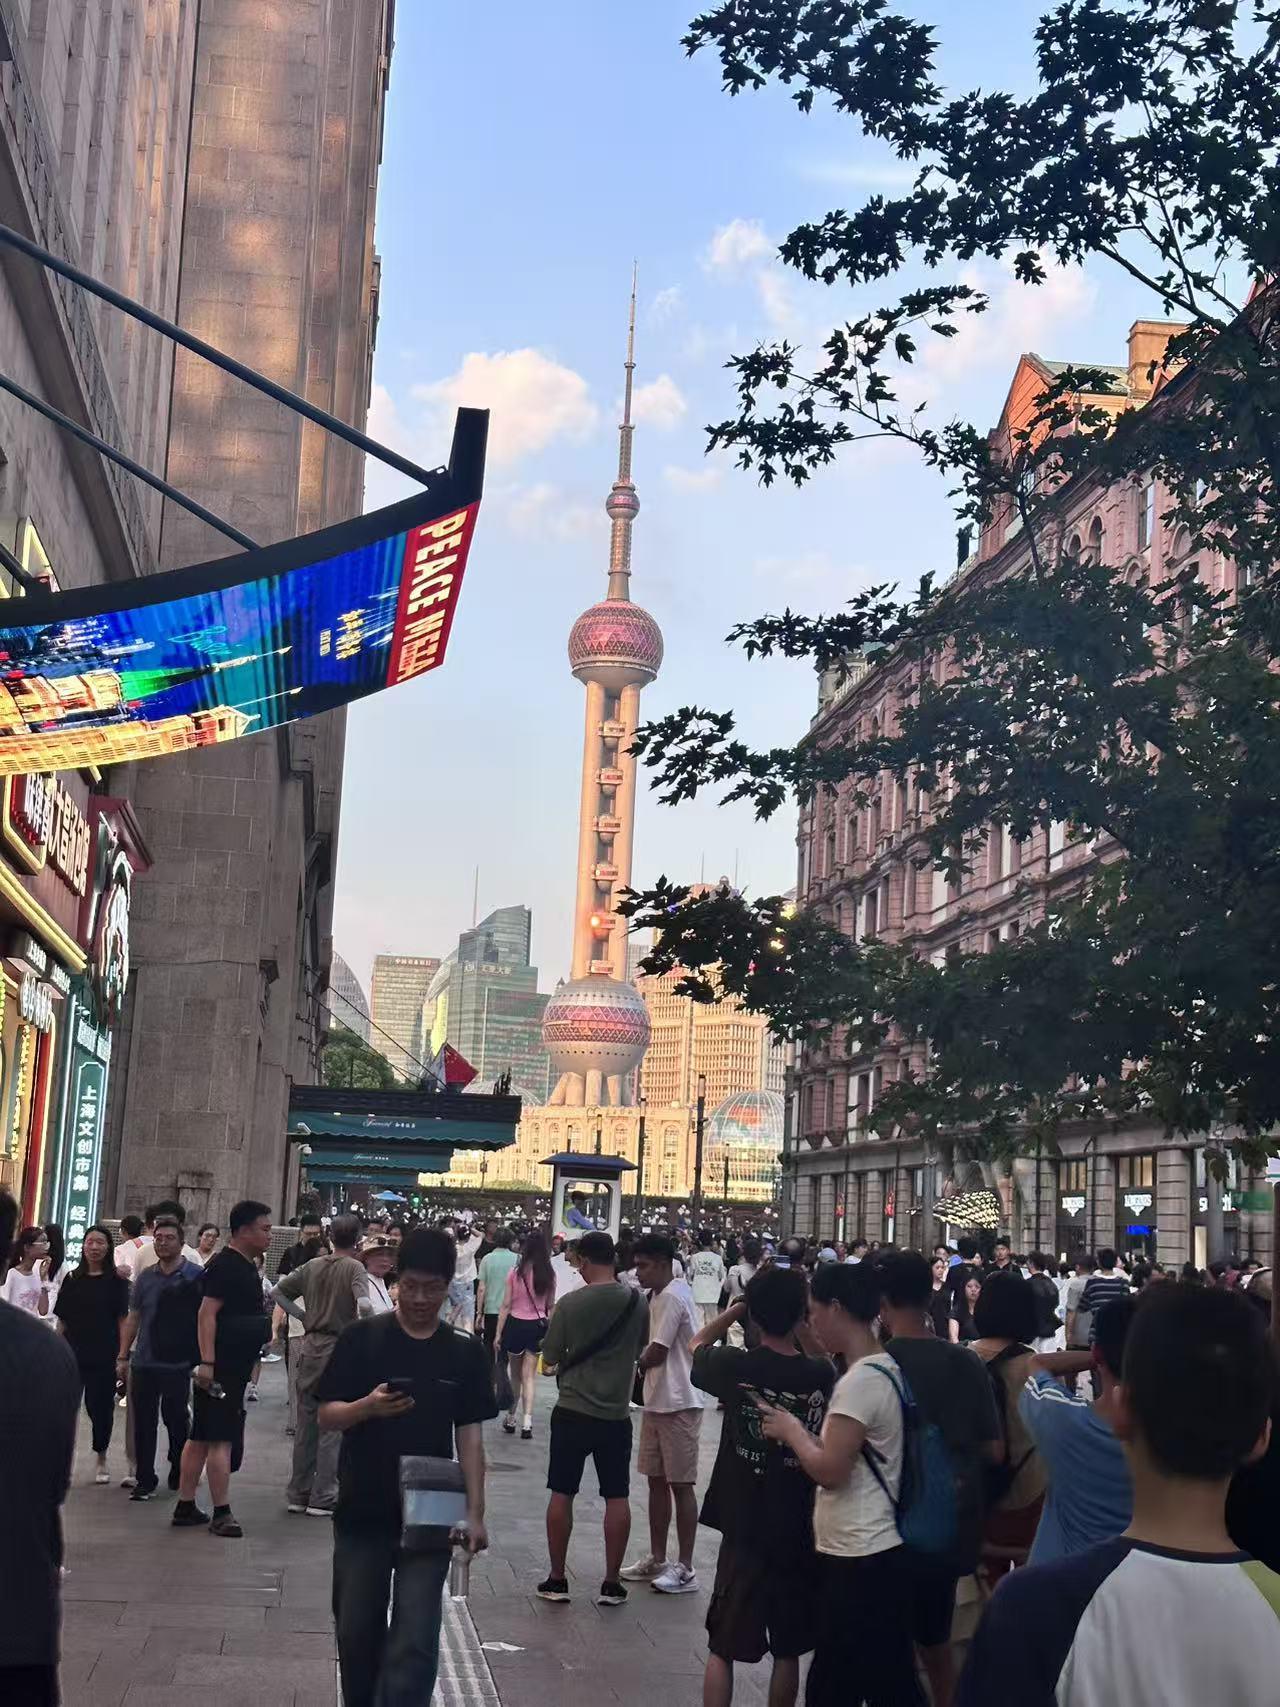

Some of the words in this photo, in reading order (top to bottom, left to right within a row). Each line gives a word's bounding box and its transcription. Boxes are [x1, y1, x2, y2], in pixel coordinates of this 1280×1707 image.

[407, 510, 468, 615] PEACE
[72, 1085, 97, 1191] 上海文创市集
